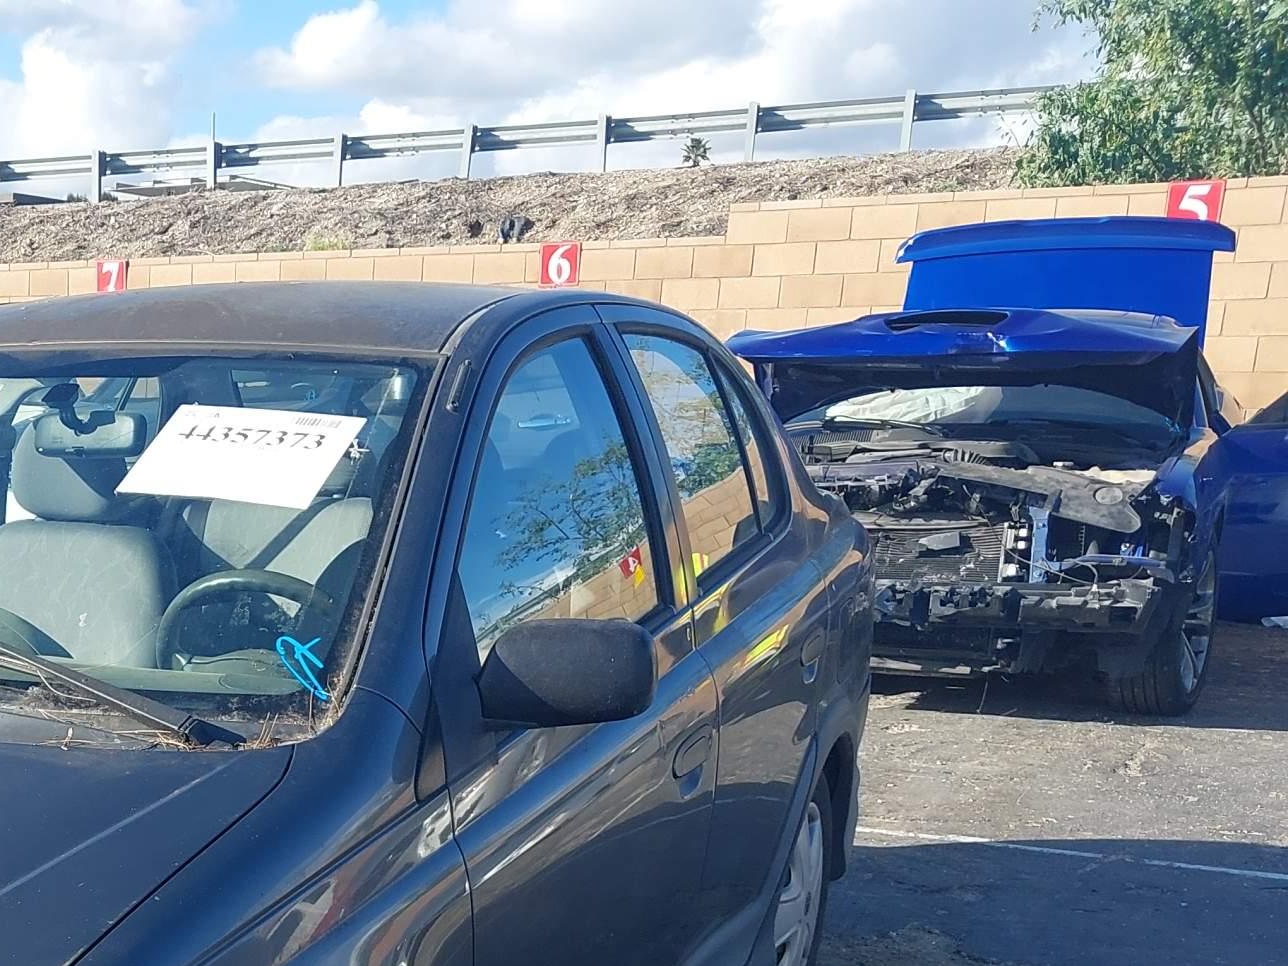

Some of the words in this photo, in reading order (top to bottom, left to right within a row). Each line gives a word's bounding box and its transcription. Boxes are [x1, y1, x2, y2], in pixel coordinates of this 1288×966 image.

[1178, 184, 1212, 220] 5
[102, 261, 120, 292] 7
[547, 244, 572, 284] 6
[177, 424, 326, 449] 44357373
